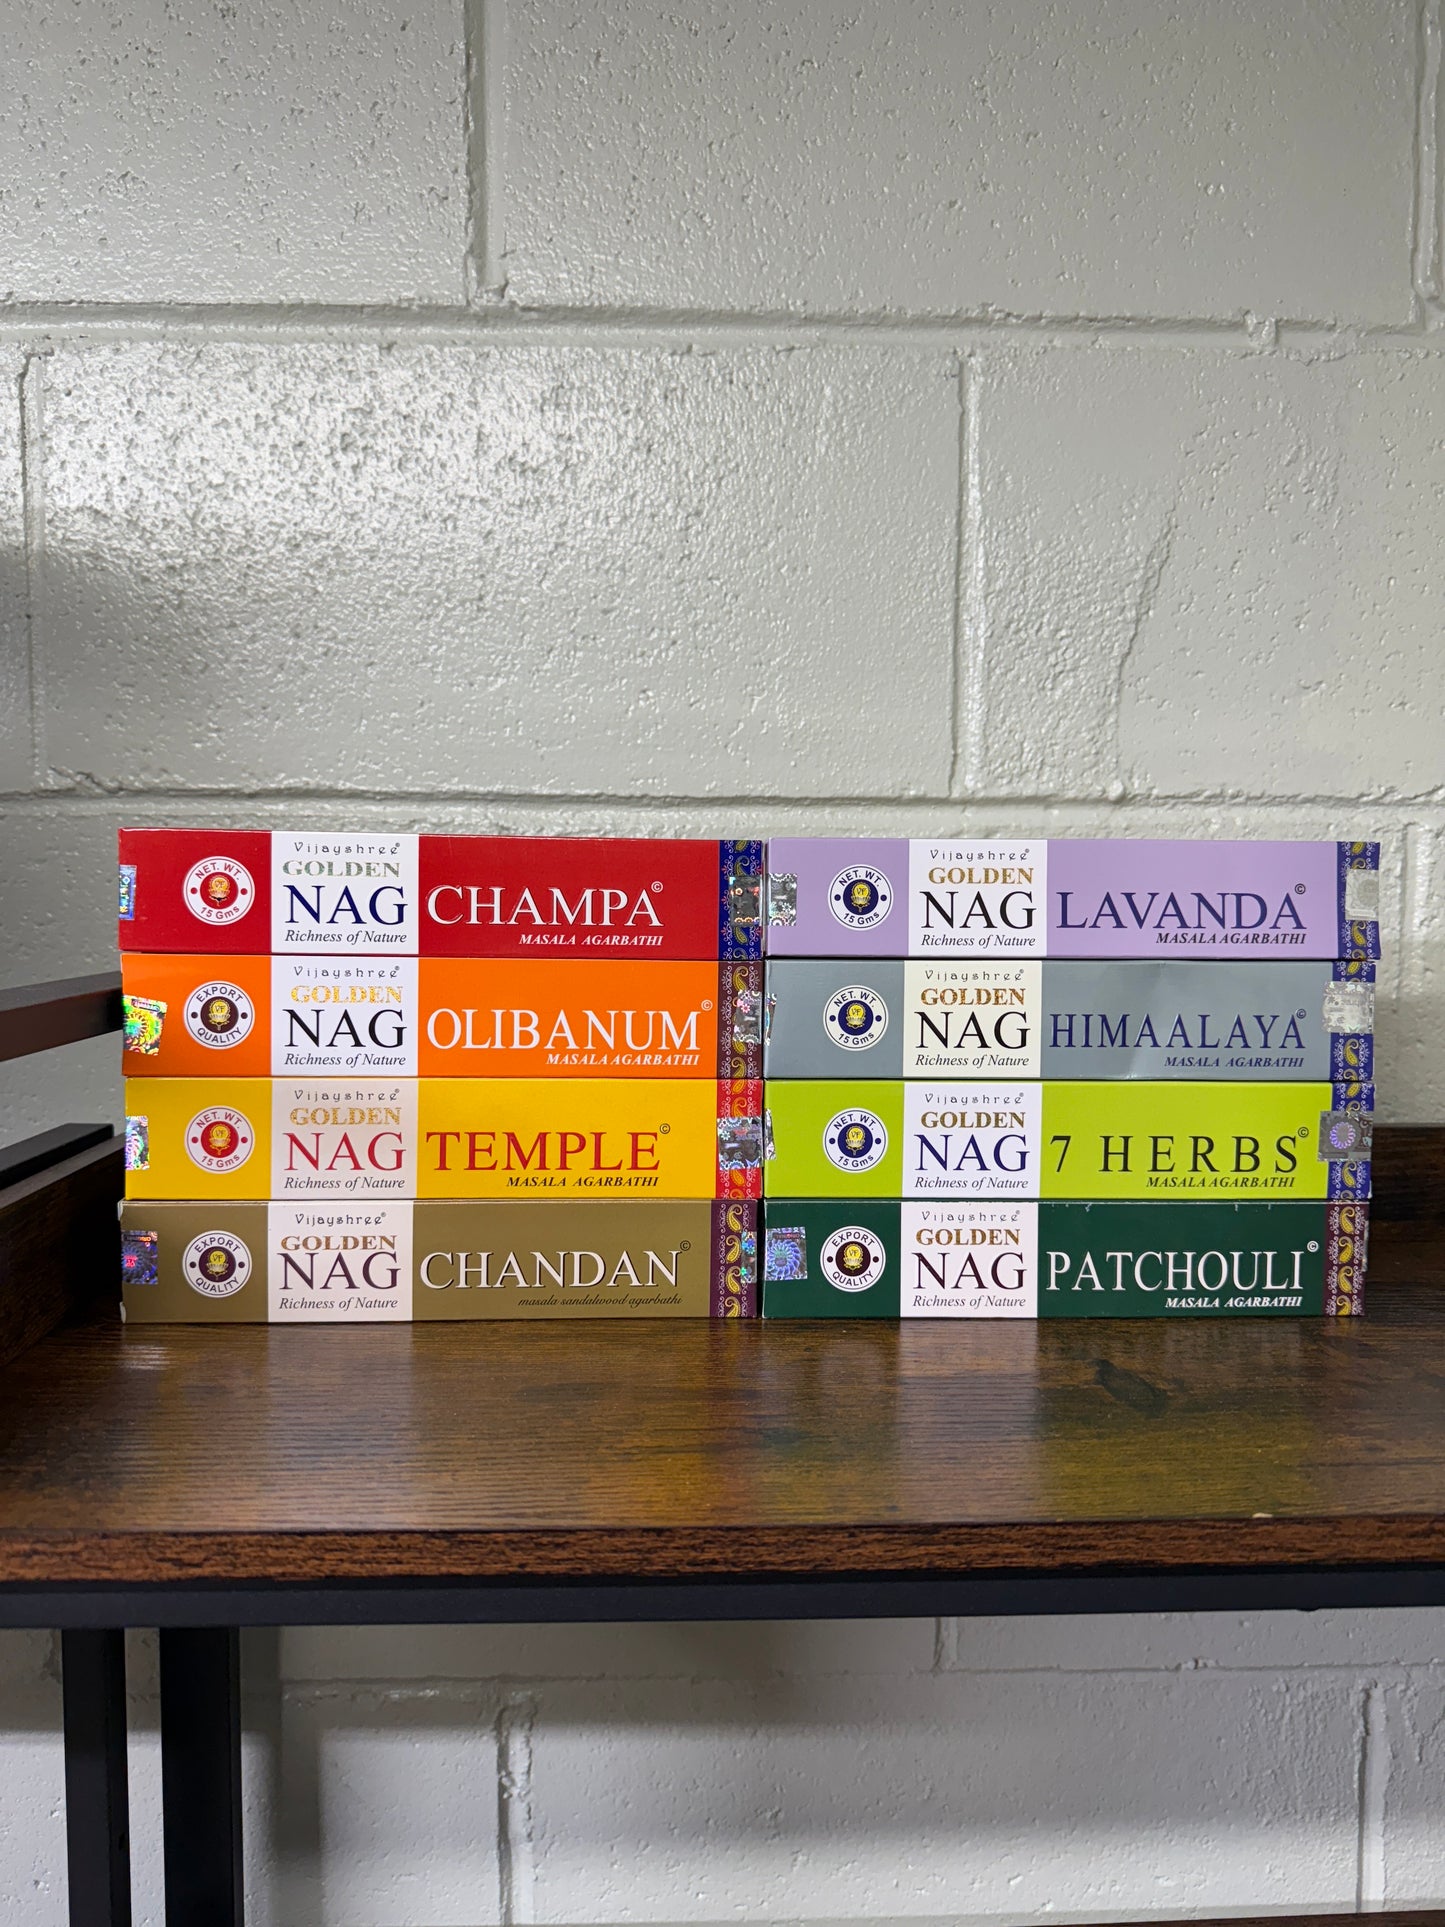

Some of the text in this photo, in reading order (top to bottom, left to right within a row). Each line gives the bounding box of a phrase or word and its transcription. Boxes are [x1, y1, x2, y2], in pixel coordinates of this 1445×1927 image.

[195, 863, 240, 880] NET. WT.
[282, 860, 400, 877] GOLDEN
[928, 867, 1034, 884] GOLDEN
[838, 870, 880, 887] NET. WT.
[284, 884, 409, 925] NAG
[919, 890, 1037, 930] NAG
[201, 906, 240, 920] 15 Gms
[843, 911, 880, 925] 15 Gms
[285, 930, 407, 945] Richness of Nature
[519, 934, 663, 946] MASALA AGARBATHI
[920, 934, 1035, 949] Richness of Nature
[1156, 933, 1307, 944] MASALA AGARBATHI
[196, 986, 243, 1002] EXPORT
[291, 985, 403, 1003] GOLDEN
[834, 991, 876, 1008] NET. WT.
[920, 988, 1025, 1006] GOLDEN
[197, 1027, 242, 1043] QUALITY
[284, 1009, 409, 1049] NAG
[914, 1011, 1030, 1049] NAG
[838, 1031, 875, 1046] 15 Gms
[285, 1053, 407, 1068] Richness of Nature
[545, 1054, 699, 1066] MASALA AGARBATHI
[916, 1055, 1029, 1070] Richness of Nature
[1164, 1056, 1304, 1067] MASALA AGARBATHI
[196, 1112, 241, 1129] NET. WT.
[290, 1107, 401, 1125] GOLDEN
[833, 1114, 876, 1130] NET. WT.
[920, 1111, 1025, 1129] GOLDEN
[284, 1131, 408, 1171] NAG
[913, 1134, 1029, 1172] NAG
[1049, 1134, 1070, 1173] 7
[201, 1154, 241, 1168] 15 Gms
[838, 1154, 874, 1168] 15 Gms
[284, 1176, 405, 1191] Richness of Nature
[506, 1176, 659, 1187] MASALA AGARBATHI
[915, 1177, 1028, 1191] Richness of Nature
[1146, 1177, 1295, 1188] MASALA AGARBATHI
[194, 1236, 241, 1252] EXPORT
[281, 1235, 396, 1251] GOLDEN
[831, 1232, 876, 1247] EXPORT
[916, 1228, 1020, 1246] GOLDEN
[279, 1252, 400, 1291] NAG
[912, 1251, 1028, 1290] NAG
[195, 1276, 240, 1293] QUALITY
[831, 1271, 875, 1287] QUALITY
[278, 1297, 397, 1312] Richness of Nature
[518, 1294, 683, 1310] masala sandalwood agarbathi
[913, 1296, 1026, 1310] Richness of Nature
[1165, 1296, 1301, 1307] MASALA AGARBATHI
